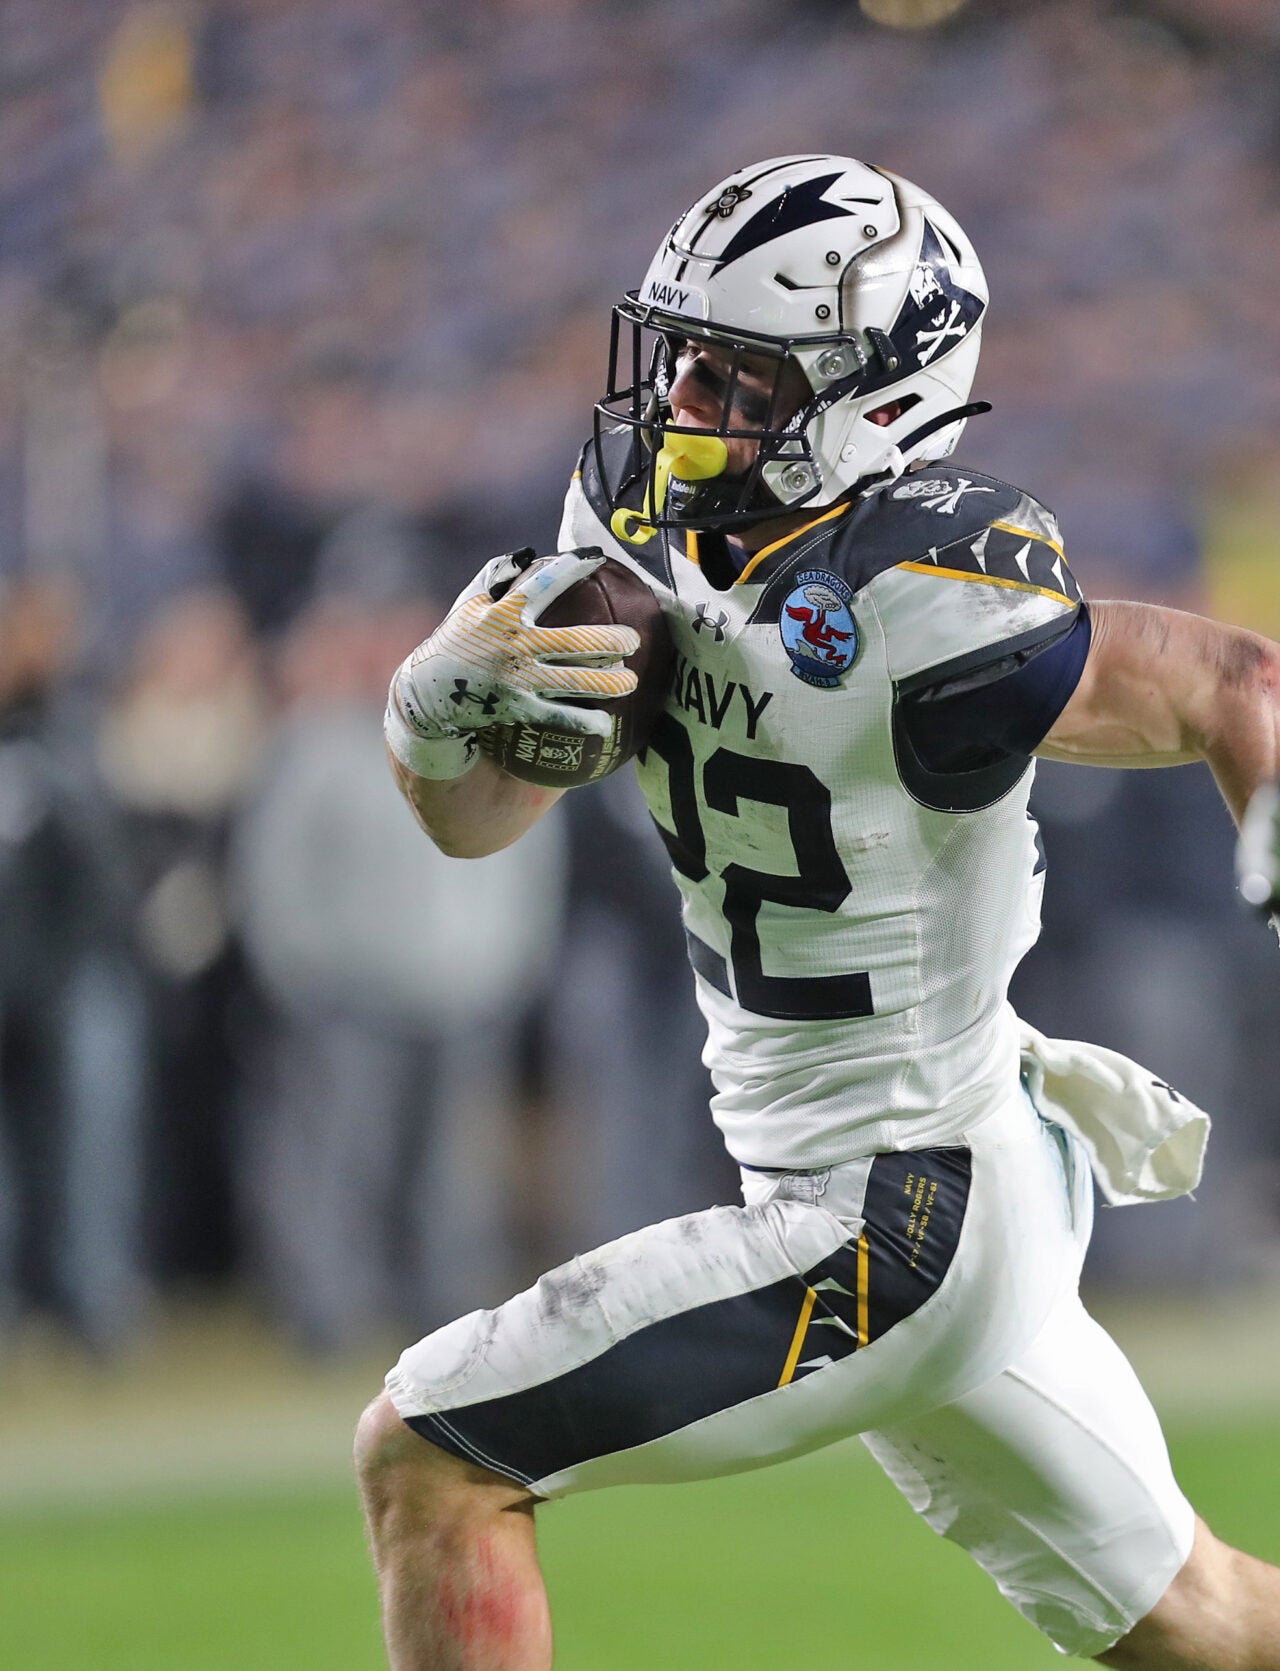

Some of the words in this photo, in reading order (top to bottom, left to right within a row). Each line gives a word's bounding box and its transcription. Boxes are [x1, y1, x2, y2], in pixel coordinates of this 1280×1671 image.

[648, 281, 690, 310] NAVY
[799, 571, 814, 582] SEA
[816, 572, 850, 600] DRAGONS
[515, 724, 540, 762] NAVY
[637, 709, 875, 1020] 22
[904, 1172, 915, 1195] NAVY
[906, 1212, 917, 1239] JOLLY
[912, 1176, 927, 1211] ROGERS
